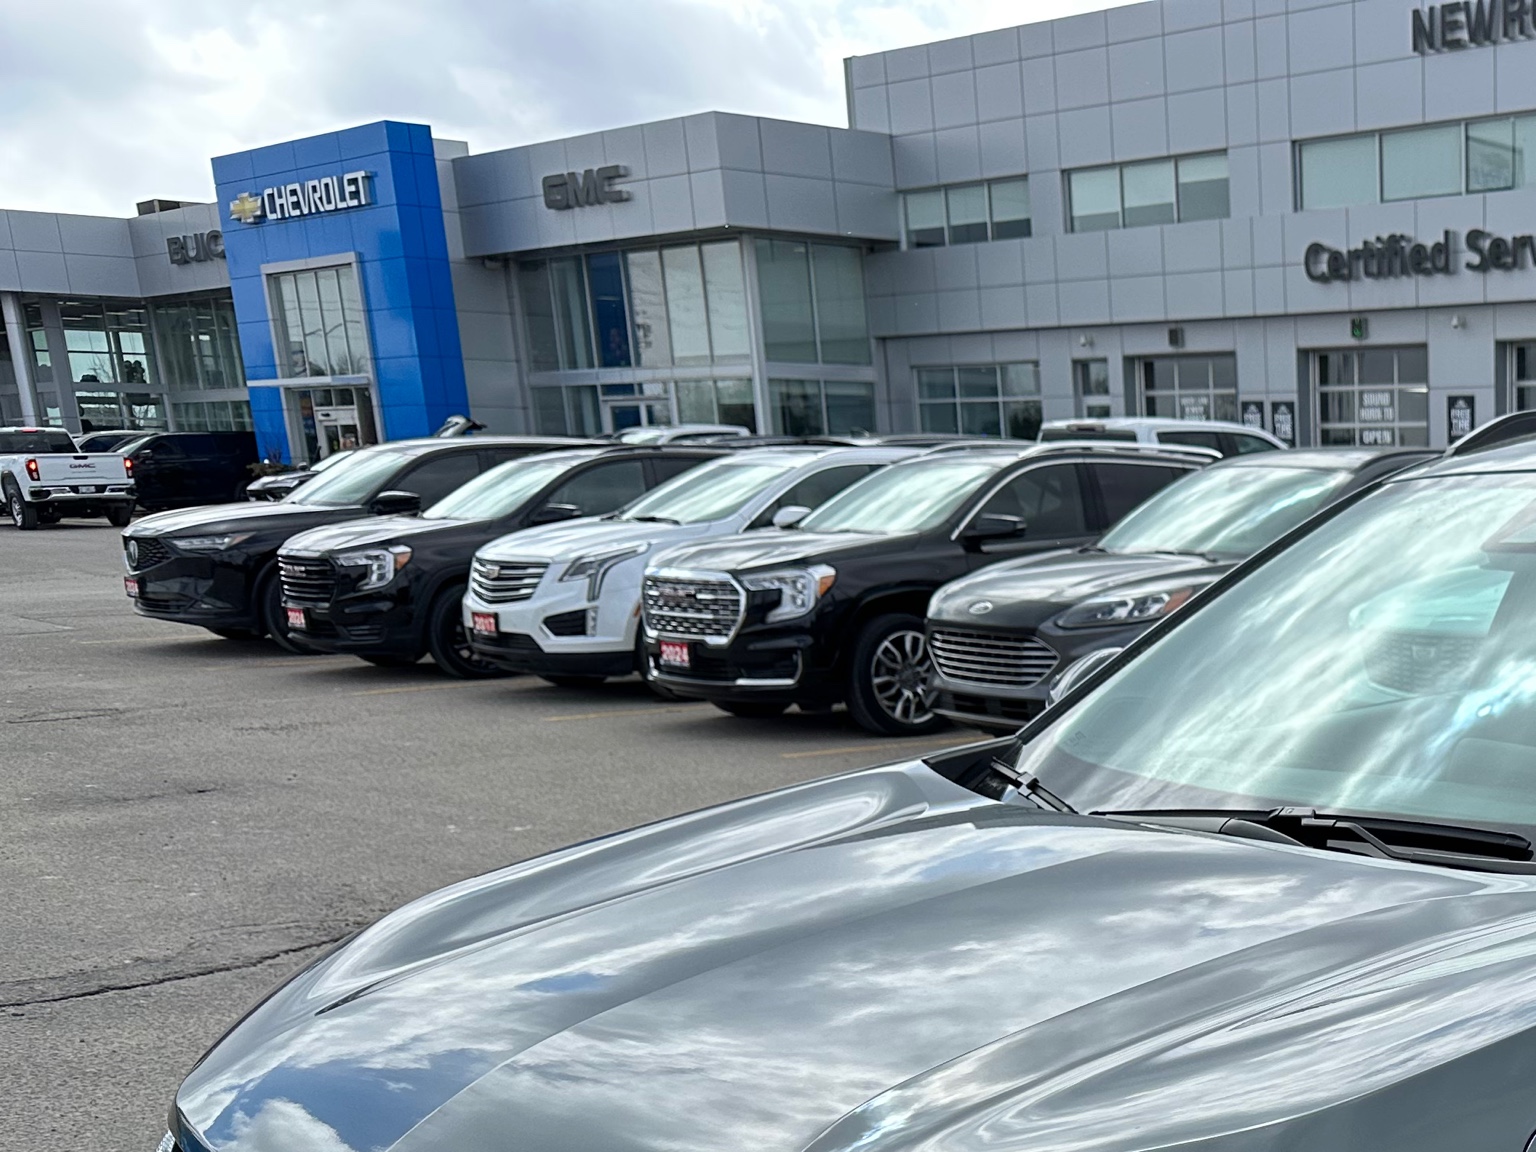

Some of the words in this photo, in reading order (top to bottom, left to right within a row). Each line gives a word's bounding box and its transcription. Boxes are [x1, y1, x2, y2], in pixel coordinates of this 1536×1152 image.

[263, 170, 371, 220] CHEVROLET
[542, 165, 632, 210] GMC
[1305, 229, 1460, 283] Certified
[1362, 430, 1393, 445] OPEN
